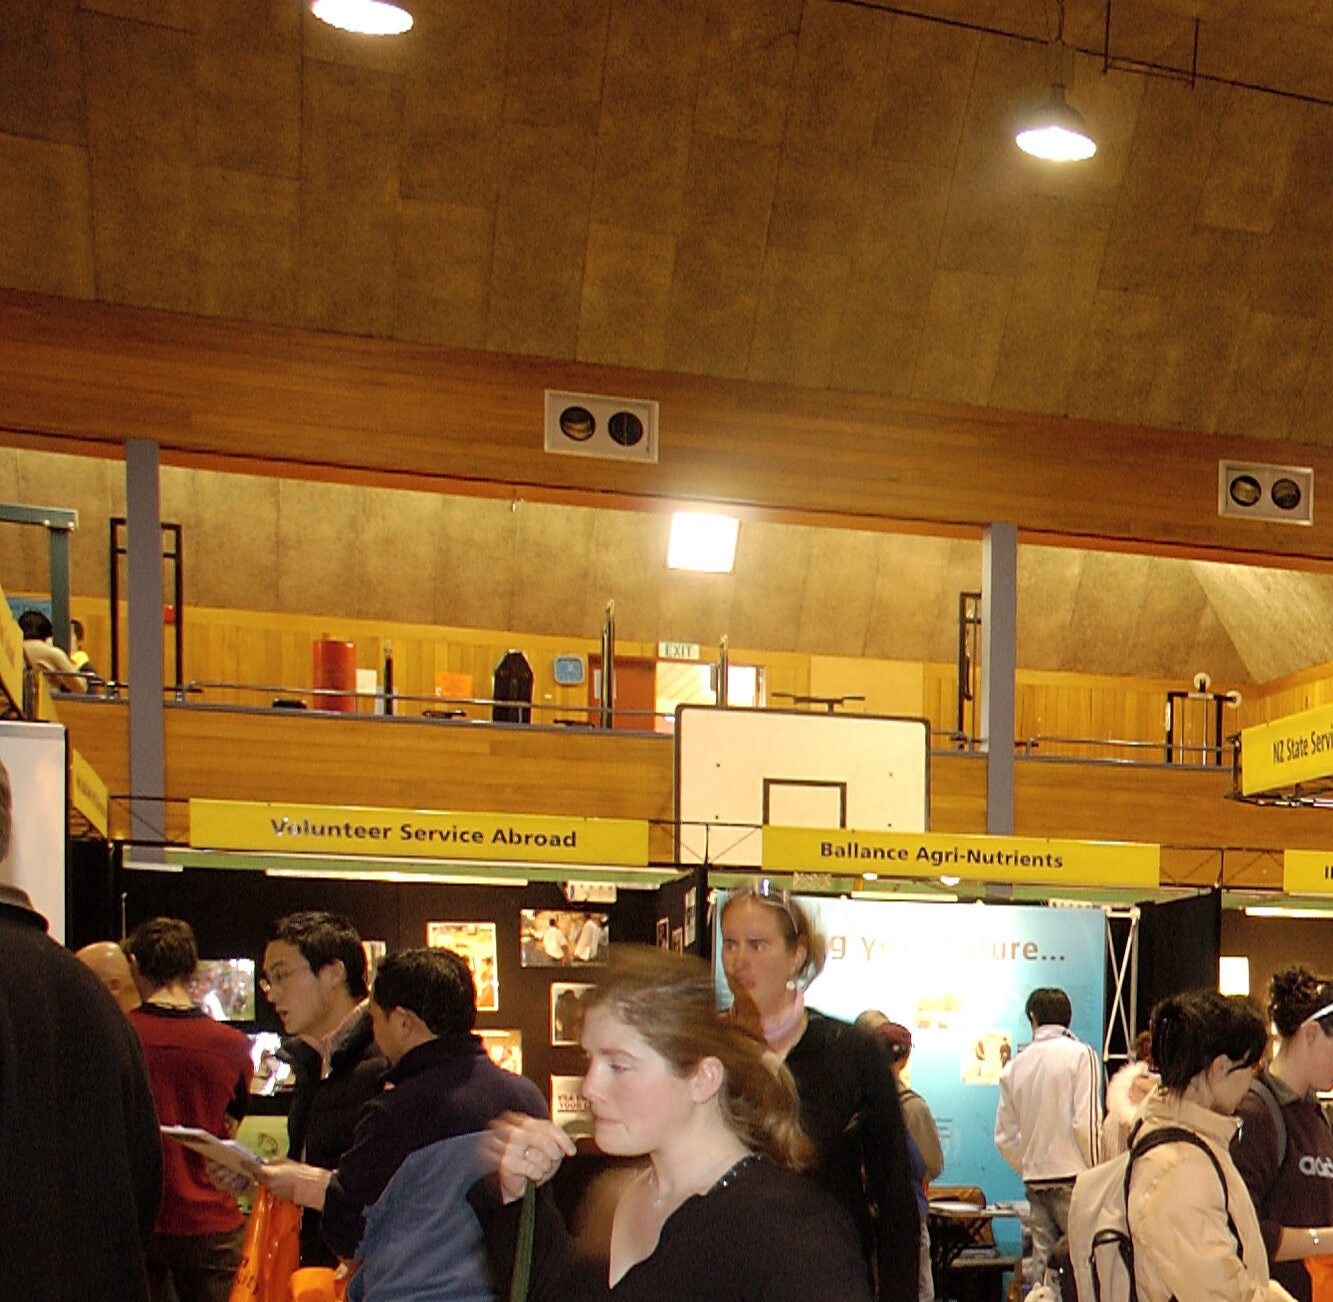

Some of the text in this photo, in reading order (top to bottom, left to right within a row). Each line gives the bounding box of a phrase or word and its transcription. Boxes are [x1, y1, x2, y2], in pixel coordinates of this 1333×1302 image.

[664, 643, 692, 657] EXIT
[1273, 740, 1285, 764] NZ
[1286, 733, 1309, 761] State
[270, 817, 578, 848] Volunteer Service Abroad
[820, 841, 1064, 869] Ballance Agri-Nutrients
